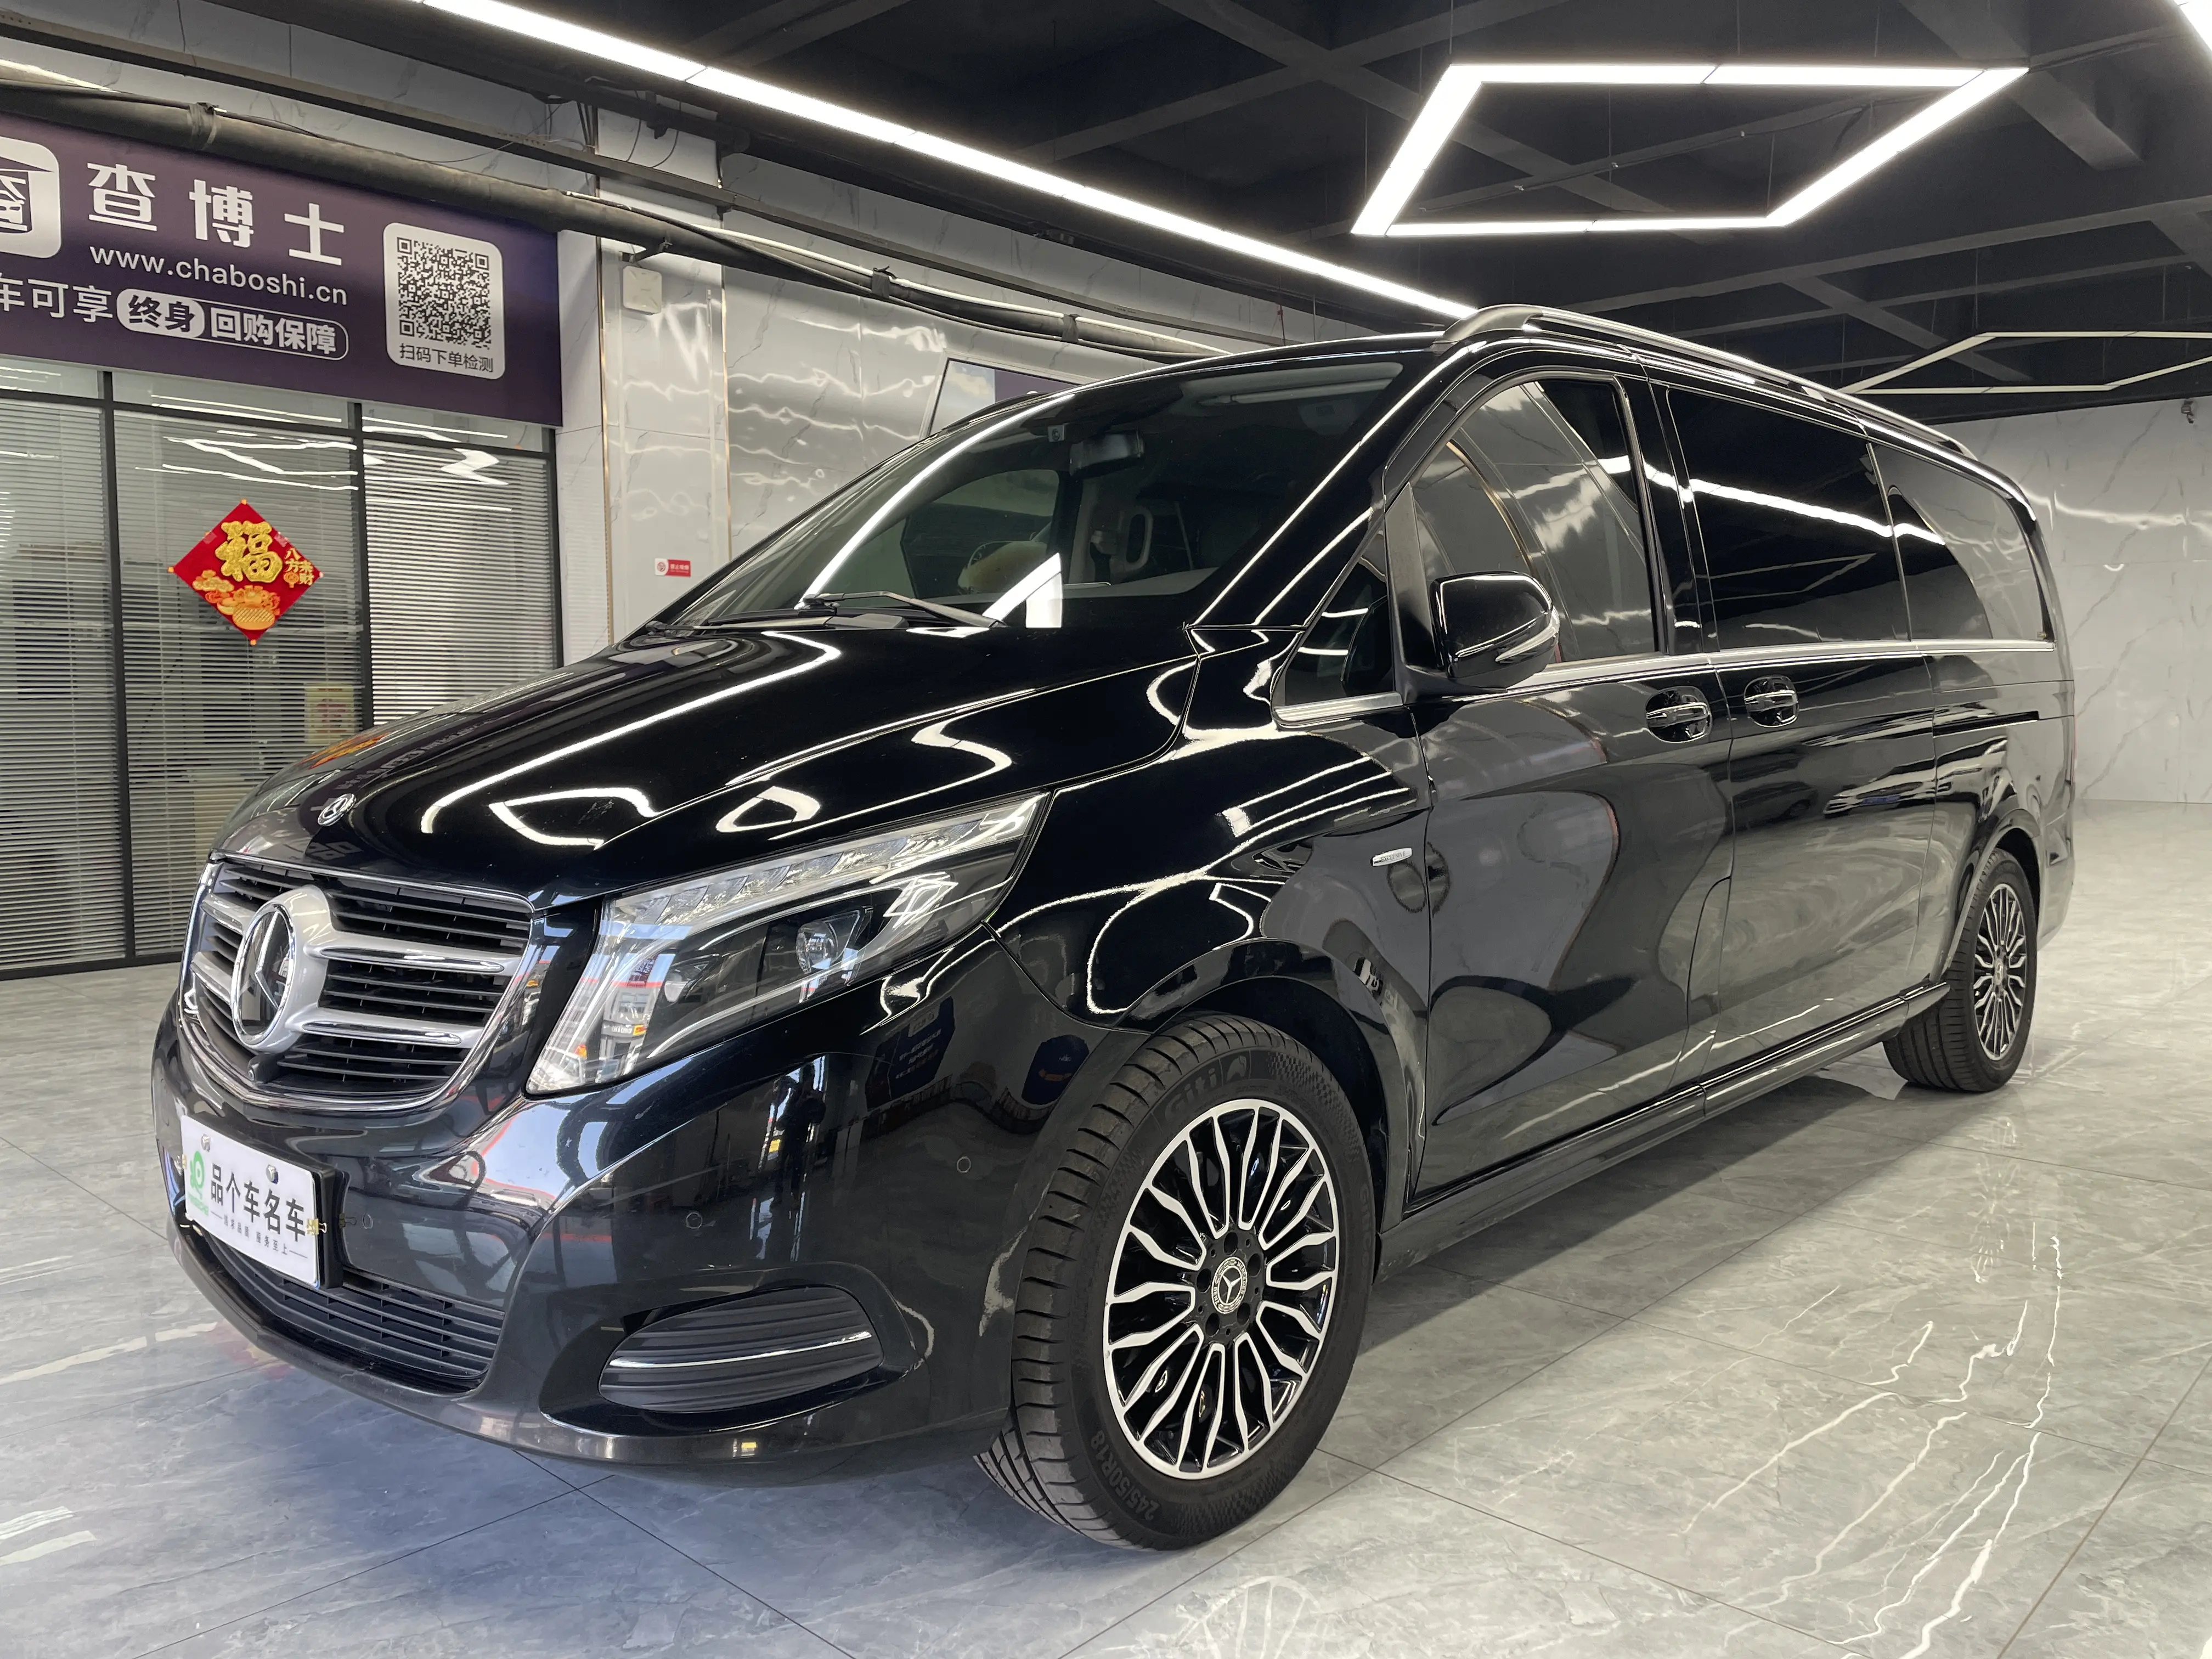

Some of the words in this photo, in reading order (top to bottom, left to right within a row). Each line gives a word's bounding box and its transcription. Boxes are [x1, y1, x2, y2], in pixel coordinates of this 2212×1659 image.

[87, 162, 345, 266] 查博士
[89, 246, 347, 306] www.chaboshi.cn
[399, 343, 494, 373] 扫码下单检测
[215, 520, 283, 583] 福
[211, 1163, 306, 1242] 品个车名车
[1090, 1430, 1161, 1521] 245/50R18
